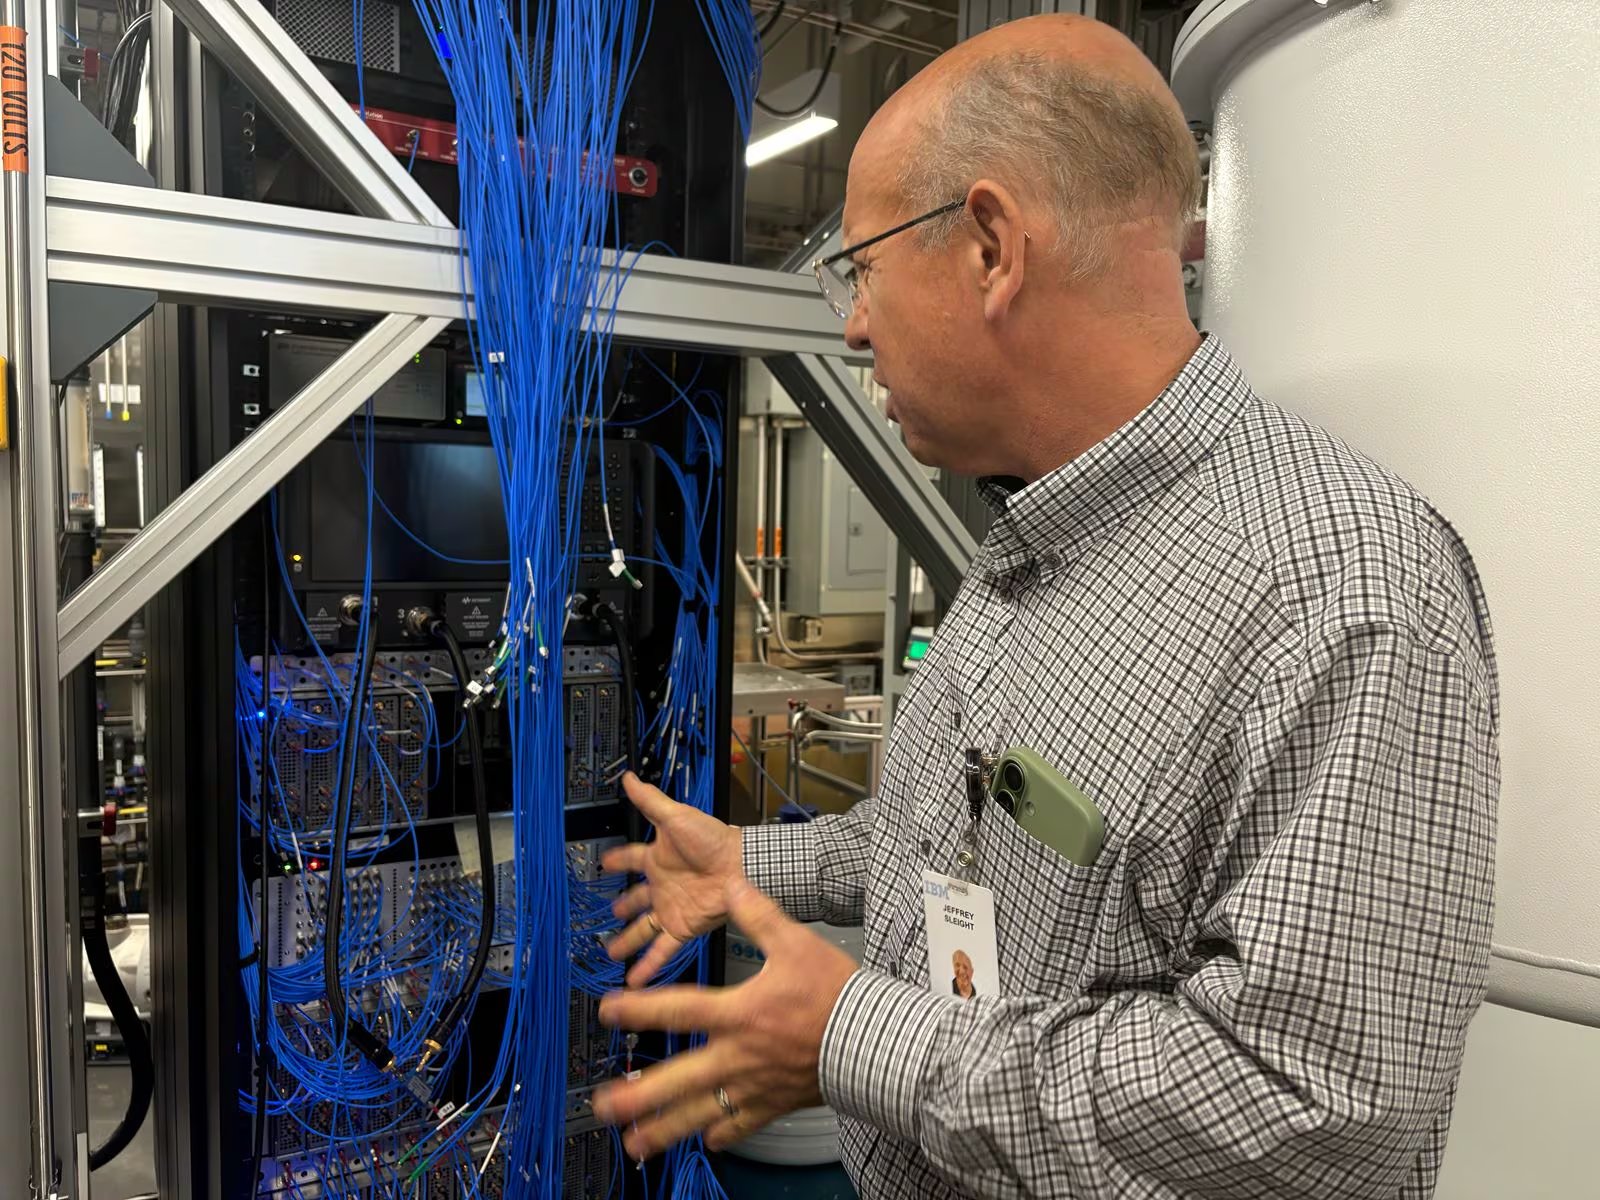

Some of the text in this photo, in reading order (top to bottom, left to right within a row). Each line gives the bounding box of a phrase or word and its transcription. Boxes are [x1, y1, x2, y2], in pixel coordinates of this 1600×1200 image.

[1, 42, 29, 157] 120 VOLTS
[924, 880, 950, 900] IBM
[944, 904, 975, 920] JEFFREY
[944, 914, 975, 931] SLEIGHT
